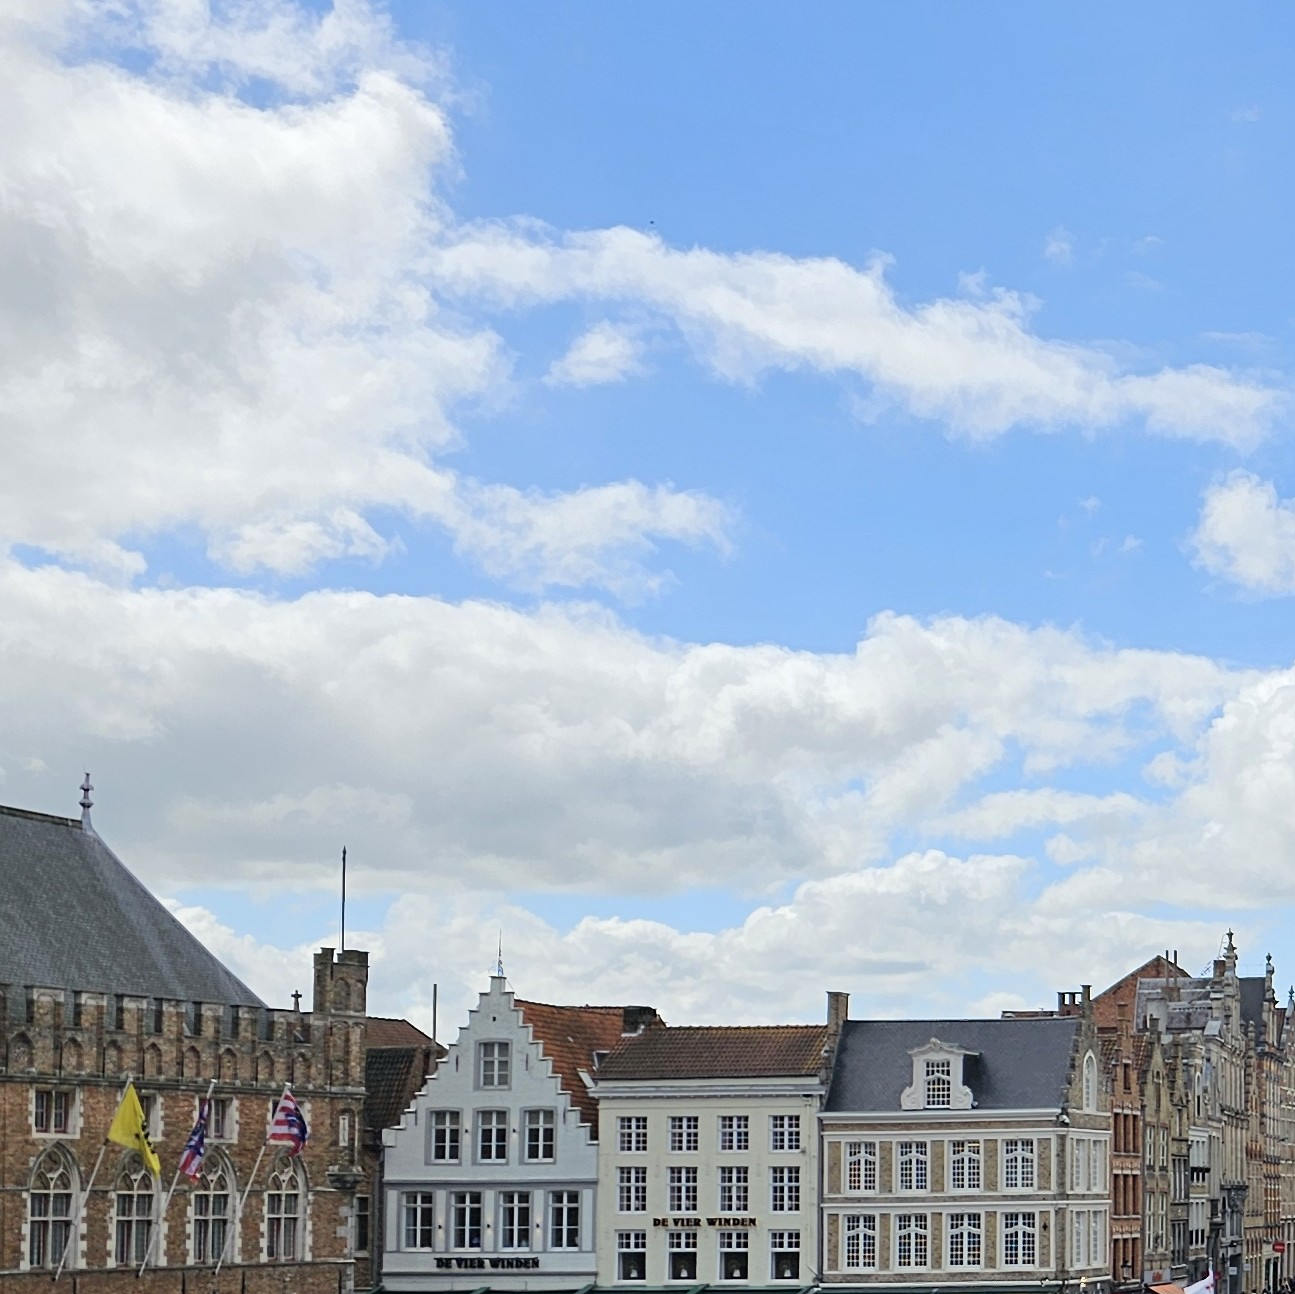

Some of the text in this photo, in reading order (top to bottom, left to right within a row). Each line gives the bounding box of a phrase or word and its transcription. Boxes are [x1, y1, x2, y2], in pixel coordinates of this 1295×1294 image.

[653, 1217, 757, 1227] DE VIER WINDEN
[435, 1257, 540, 1269] DE VIER WINDEN
